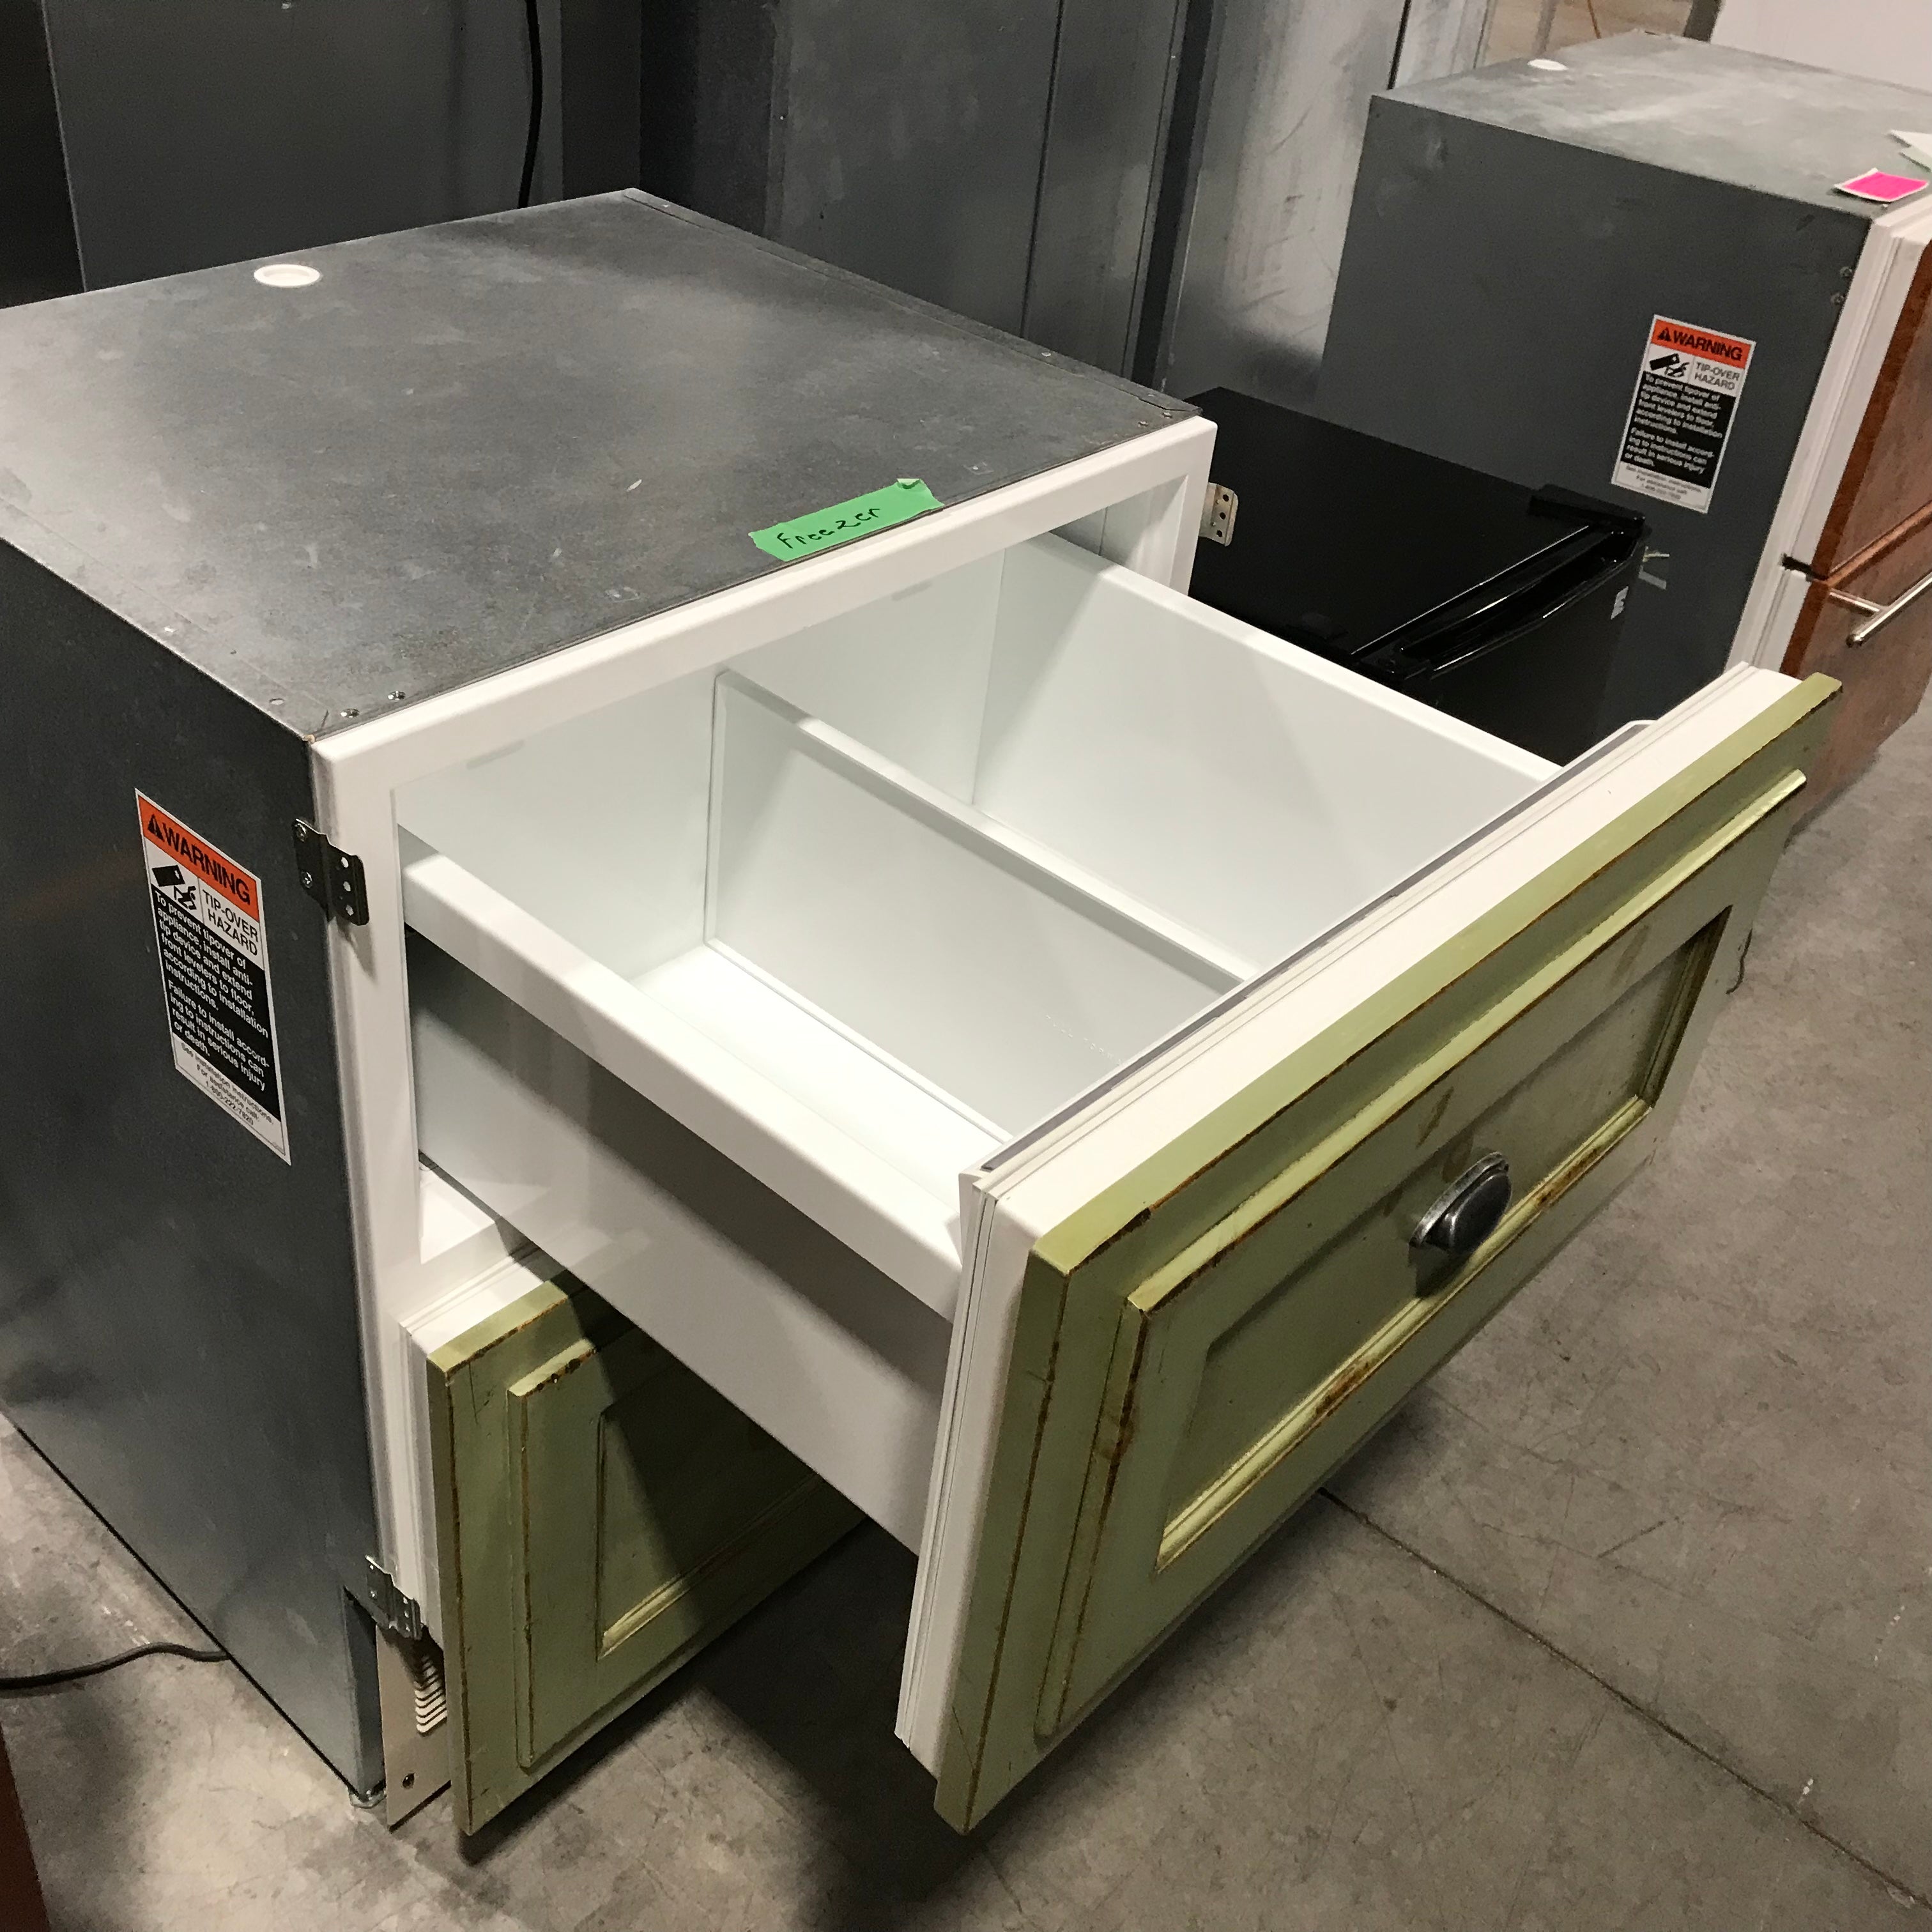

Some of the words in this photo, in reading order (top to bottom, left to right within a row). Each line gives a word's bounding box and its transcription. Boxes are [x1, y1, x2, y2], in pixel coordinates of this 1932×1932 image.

[1673, 330, 1742, 361] WARNING
[1696, 362, 1740, 381] TIP-OVER
[1694, 372, 1735, 390] HAZARD
[777, 508, 880, 549] Freezer
[162, 823, 250, 905] WARNING
[155, 890, 167, 907] To
[168, 903, 202, 935] prevent
[203, 928, 234, 960] tipover
[236, 957, 246, 970] of
[202, 889, 258, 942] TIP-OVER
[208, 908, 257, 956] HAZARD
[157, 907, 202, 949] appliance,
[203, 940, 231, 970] install
[233, 967, 253, 985] anti-
[158, 919, 171, 936] tip
[172, 931, 201, 960] device
[203, 956, 220, 974] and
[222, 970, 252, 1000] extend
[161, 933, 183, 957] front
[183, 950, 218, 985] levelers
[218, 979, 229, 993] to
[163, 949, 206, 990] according
[207, 982, 217, 997] to
[218, 990, 268, 1038] installation
[165, 960, 218, 1011] instructions.
[168, 979, 197, 1009] Failure
[197, 1004, 207, 1018] to
[208, 1012, 234, 1041] install
[236, 1038, 270, 1067] accord-
[170, 992, 184, 1013] ing
[185, 1006, 194, 1019] to
[195, 1013, 246, 1062] instructions
[247, 1059, 264, 1077] can
[172, 1008, 196, 1033] result
[196, 1026, 206, 1045] in
[207, 1037, 239, 1068] serious
[240, 1062, 265, 1091] injury
[174, 1021, 183, 1032] or
[185, 1030, 210, 1057] death.
